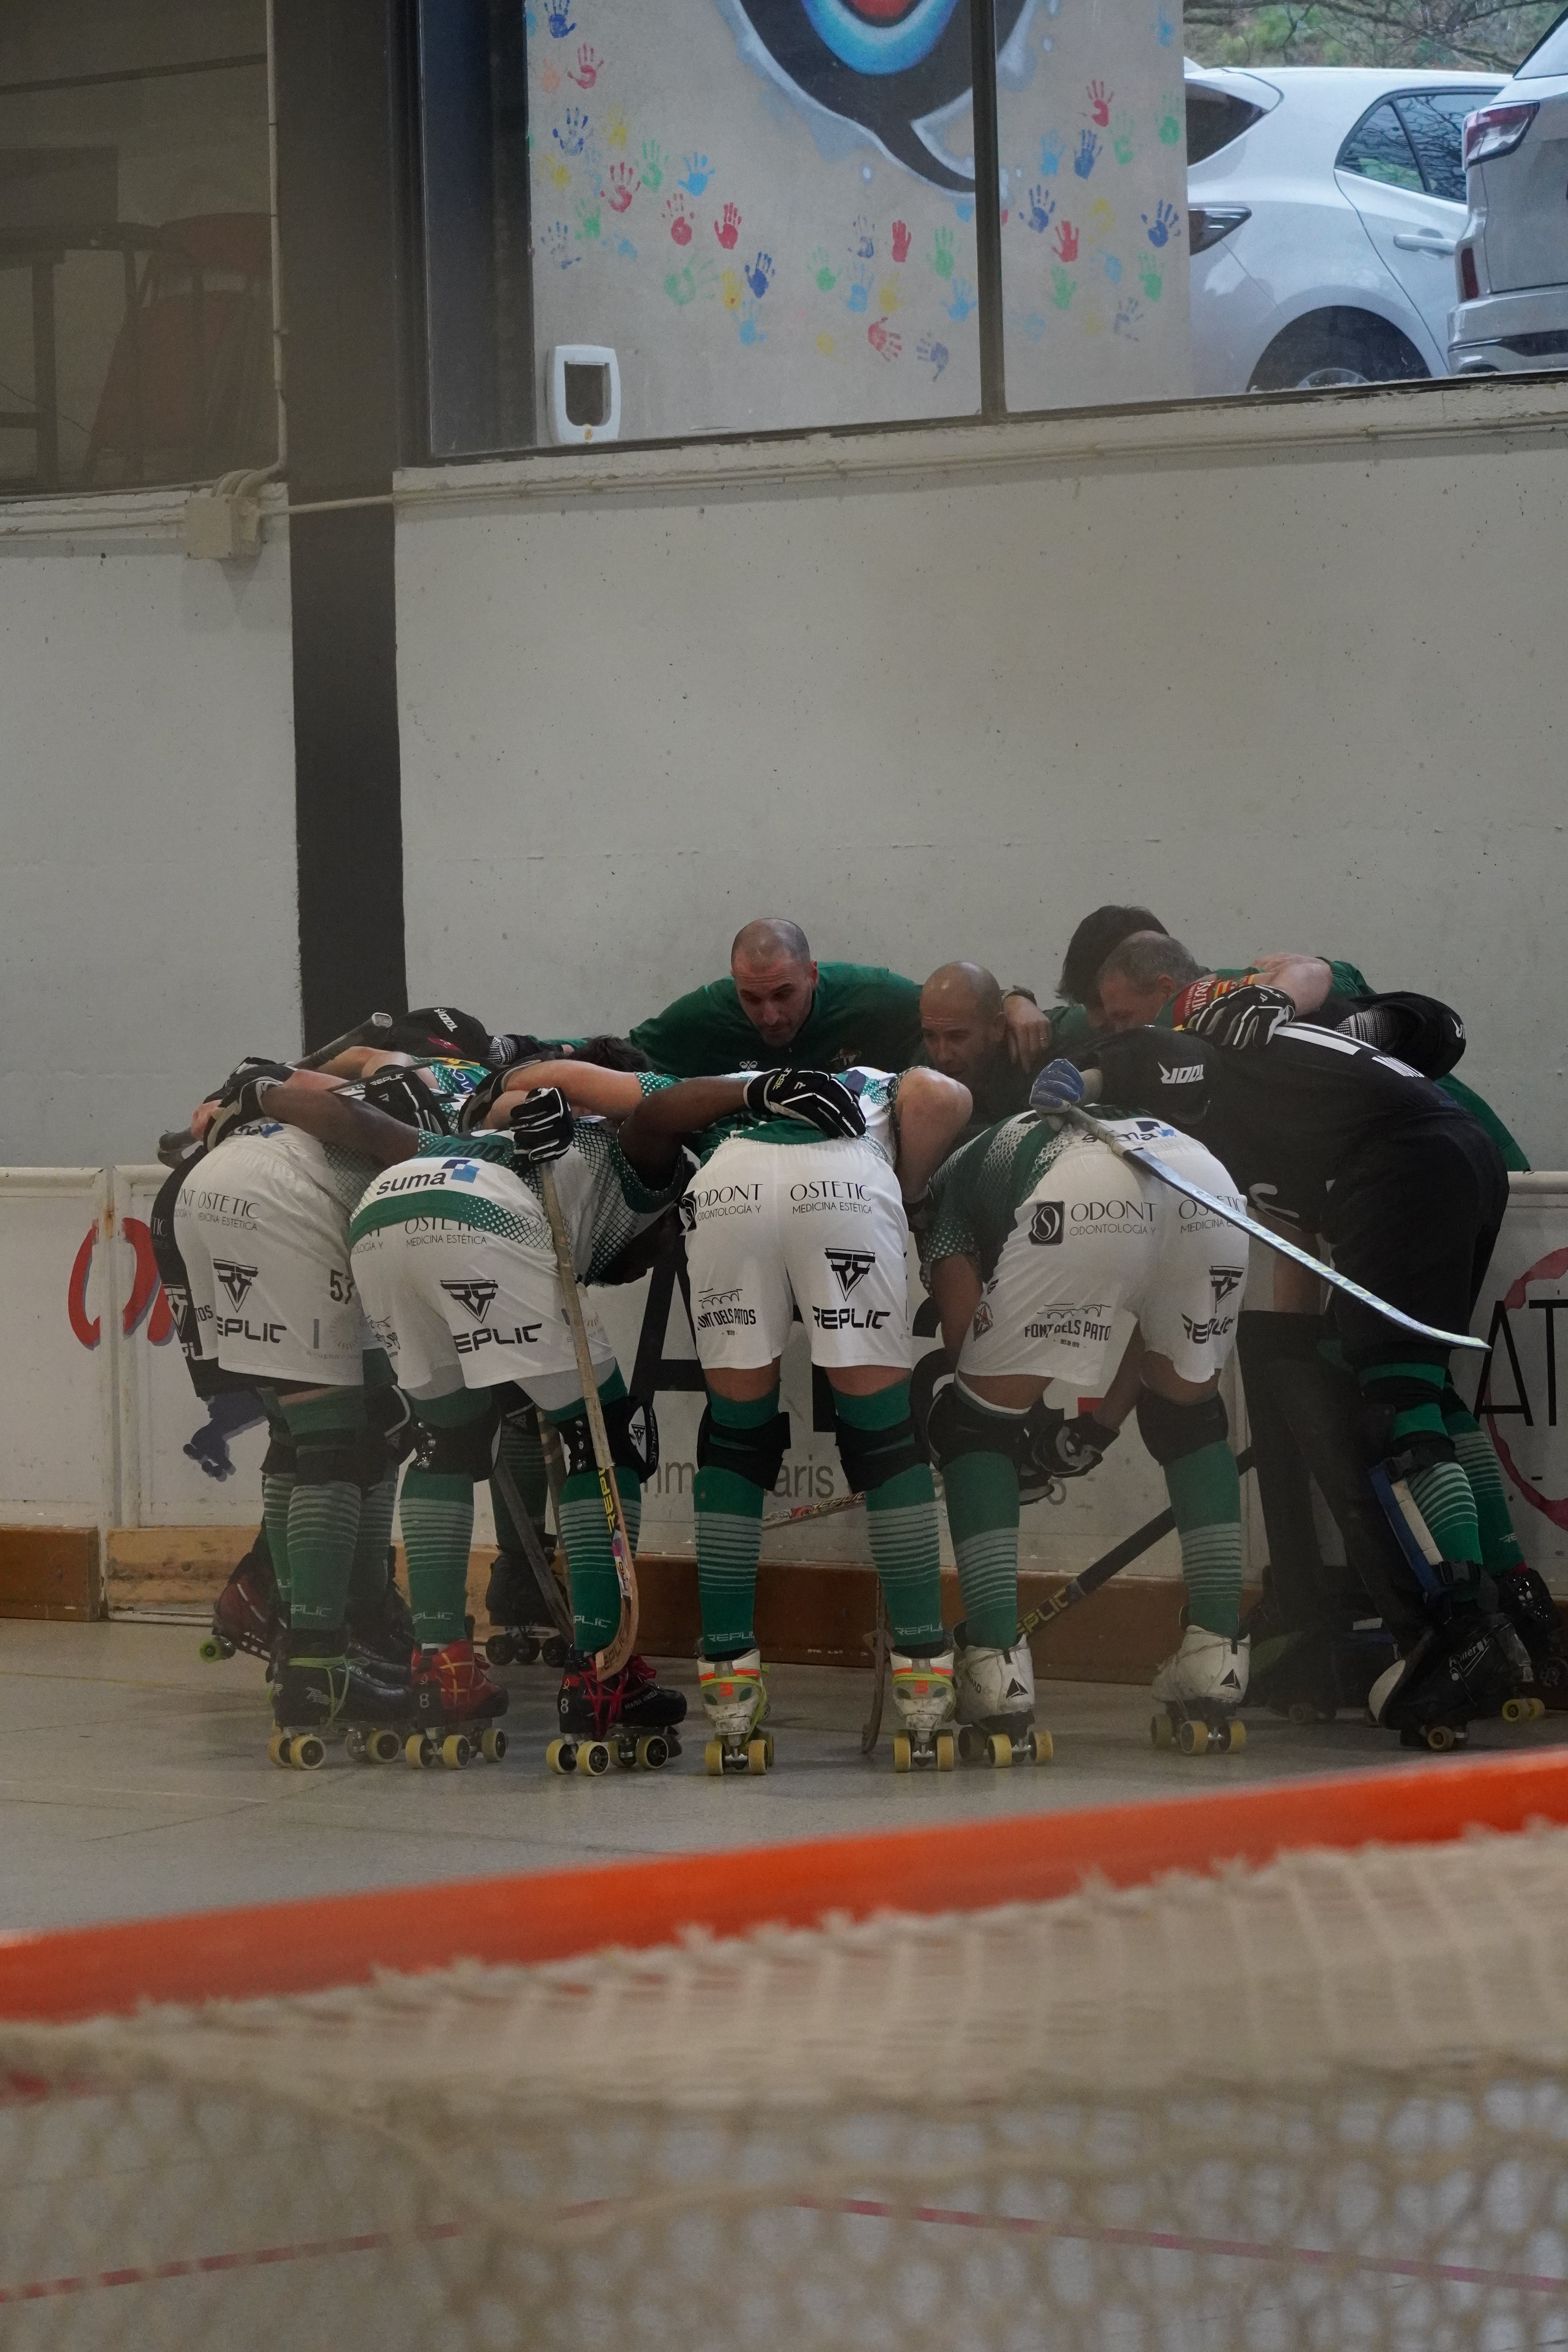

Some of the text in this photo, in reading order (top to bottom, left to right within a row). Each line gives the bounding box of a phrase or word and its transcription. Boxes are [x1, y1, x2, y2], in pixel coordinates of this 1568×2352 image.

[1082, 1132, 1158, 1143] sma
[376, 1170, 446, 1196] suma
[697, 1180, 871, 1208] ODONT OSTETIC
[198, 1192, 260, 1219] OSTETIC
[755, 1205, 762, 1214] Y
[792, 1201, 837, 1215] MEDICINA
[839, 1201, 872, 1214] ESTÉTICA
[1071, 1200, 1158, 1222] ODONT
[221, 1216, 258, 1231] ESTÉTICA
[1070, 1222, 1147, 1236] ODONTOLOGÍA
[1151, 1227, 1156, 1236] Y
[1180, 1219, 1224, 1234] MEDICINA
[353, 1241, 375, 1254] OLOGÍA
[406, 1234, 443, 1248] MEDICINA
[446, 1233, 487, 1245] ESTÉTICA
[713, 1308, 734, 1325] DELS
[734, 1308, 756, 1325] PATOS
[812, 1305, 891, 1330] REPLIC
[217, 1317, 287, 1344] EPLIC
[453, 1323, 543, 1354] EPLIC
[1024, 1319, 1111, 1341] FONT DELS PATO
[412, 1612, 454, 1624] PLIC
[573, 1615, 612, 1628] PLIC
[1015, 1588, 1070, 1636] EPLIC
[419, 1693, 430, 1708] 8
[560, 1698, 569, 1713] 8
